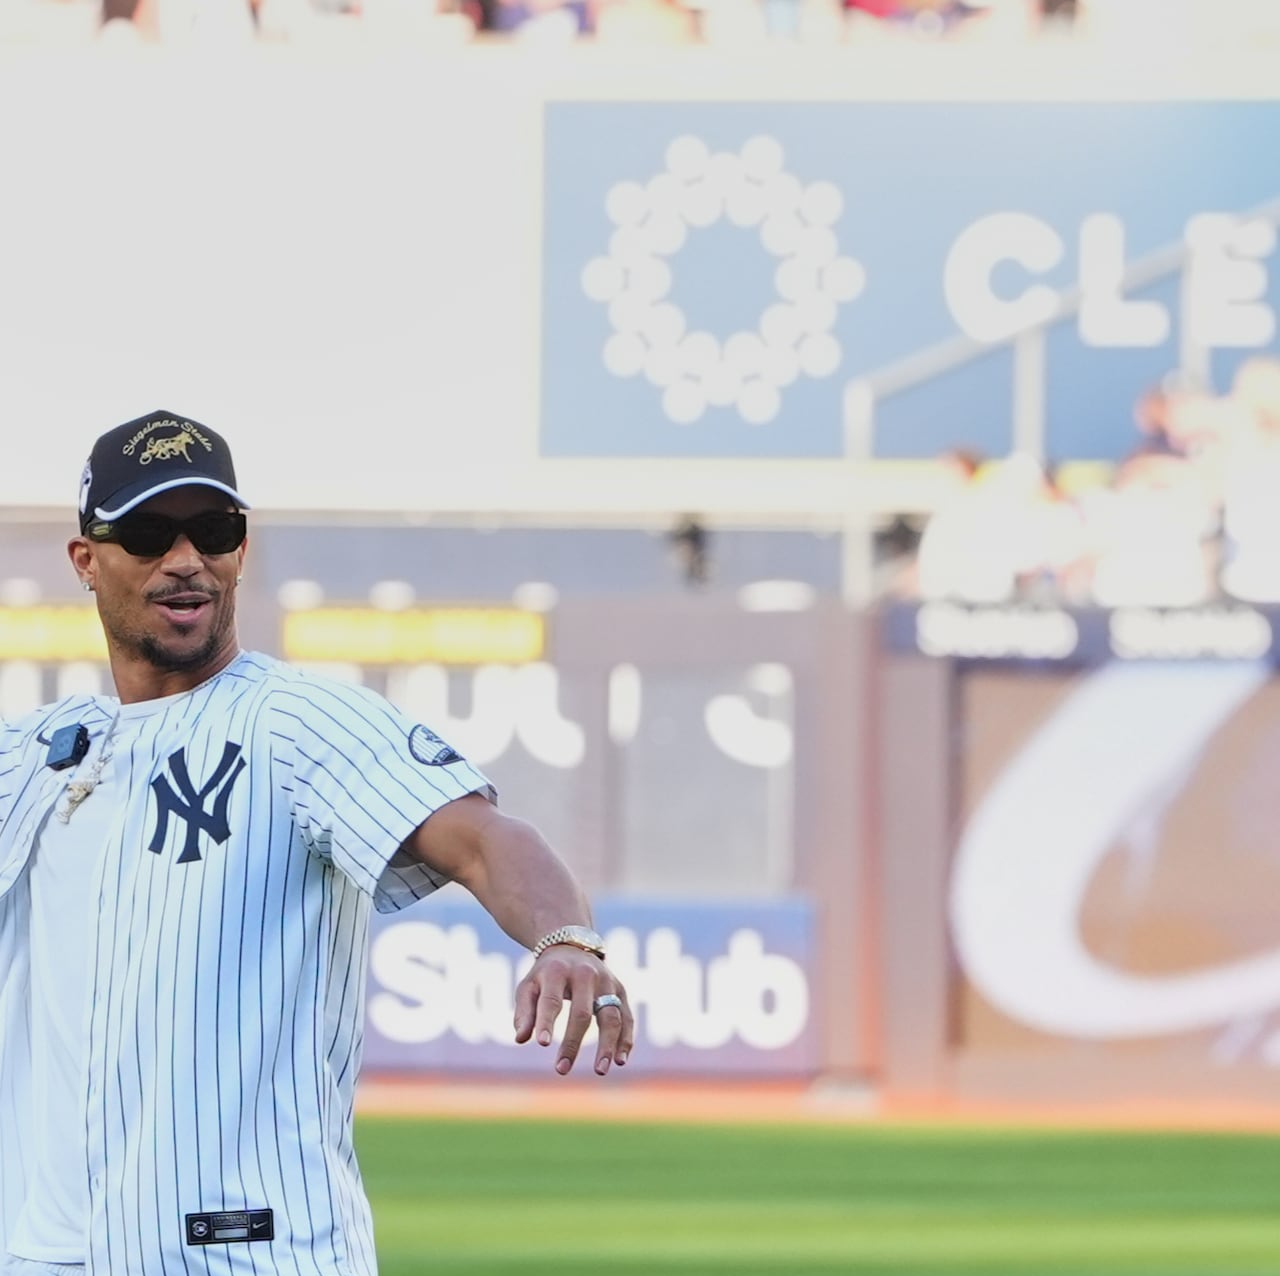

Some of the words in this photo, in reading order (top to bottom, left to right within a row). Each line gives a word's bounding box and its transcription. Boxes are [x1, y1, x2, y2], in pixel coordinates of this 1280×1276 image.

[122, 419, 179, 456] Siegelman
[180, 421, 212, 452] Stable
[148, 740, 246, 864] NY
[369, 921, 809, 1050] StuHub
